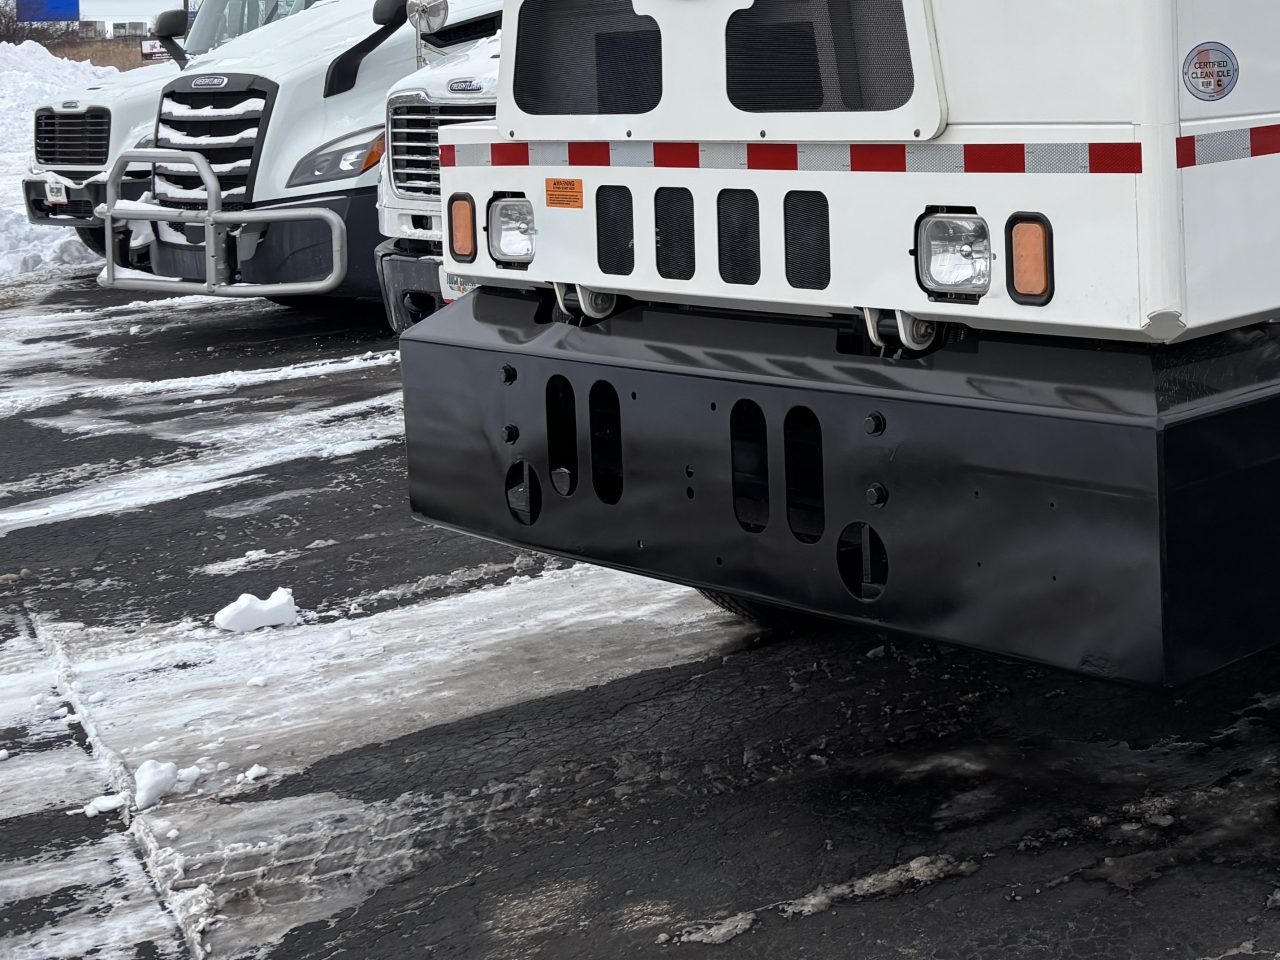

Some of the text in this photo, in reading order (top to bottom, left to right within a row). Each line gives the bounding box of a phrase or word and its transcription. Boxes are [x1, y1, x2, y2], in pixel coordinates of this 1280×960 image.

[1194, 60, 1228, 69] CERTIFIED
[1191, 69, 1232, 80] CLEAN IDLE
